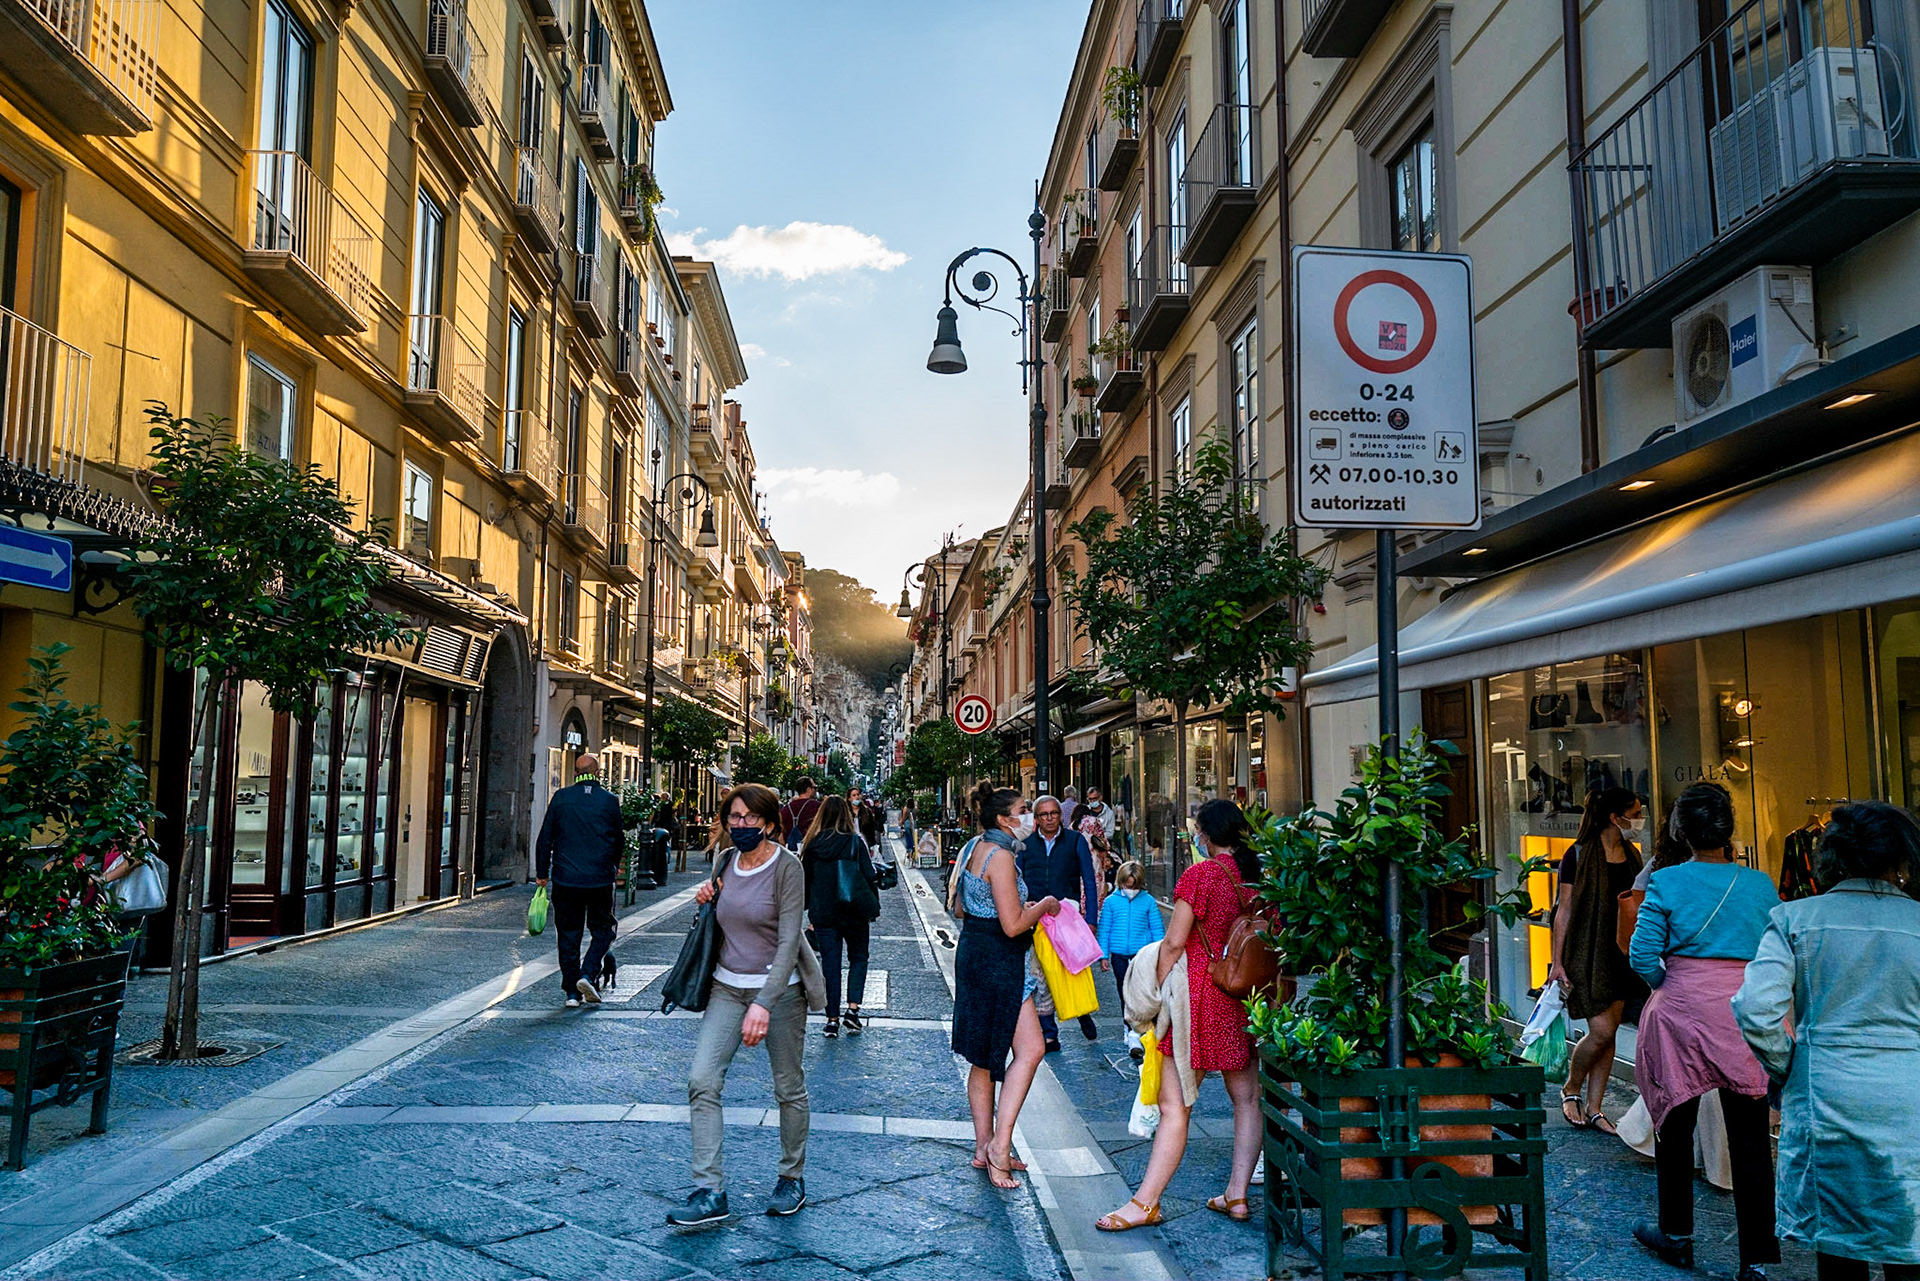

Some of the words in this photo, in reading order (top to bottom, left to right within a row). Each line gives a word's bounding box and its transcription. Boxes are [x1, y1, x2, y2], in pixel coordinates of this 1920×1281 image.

[1731, 332, 1756, 354] Haier
[1359, 383, 1415, 402] 0-24
[1309, 407, 1381, 423] eccetto:
[1382, 433, 1426, 441] complessiva
[1339, 467, 1458, 485] 07,00-10,30
[1311, 495, 1406, 511] autorizzati
[963, 704, 984, 723] 20
[1674, 764, 1732, 782] GIALA
